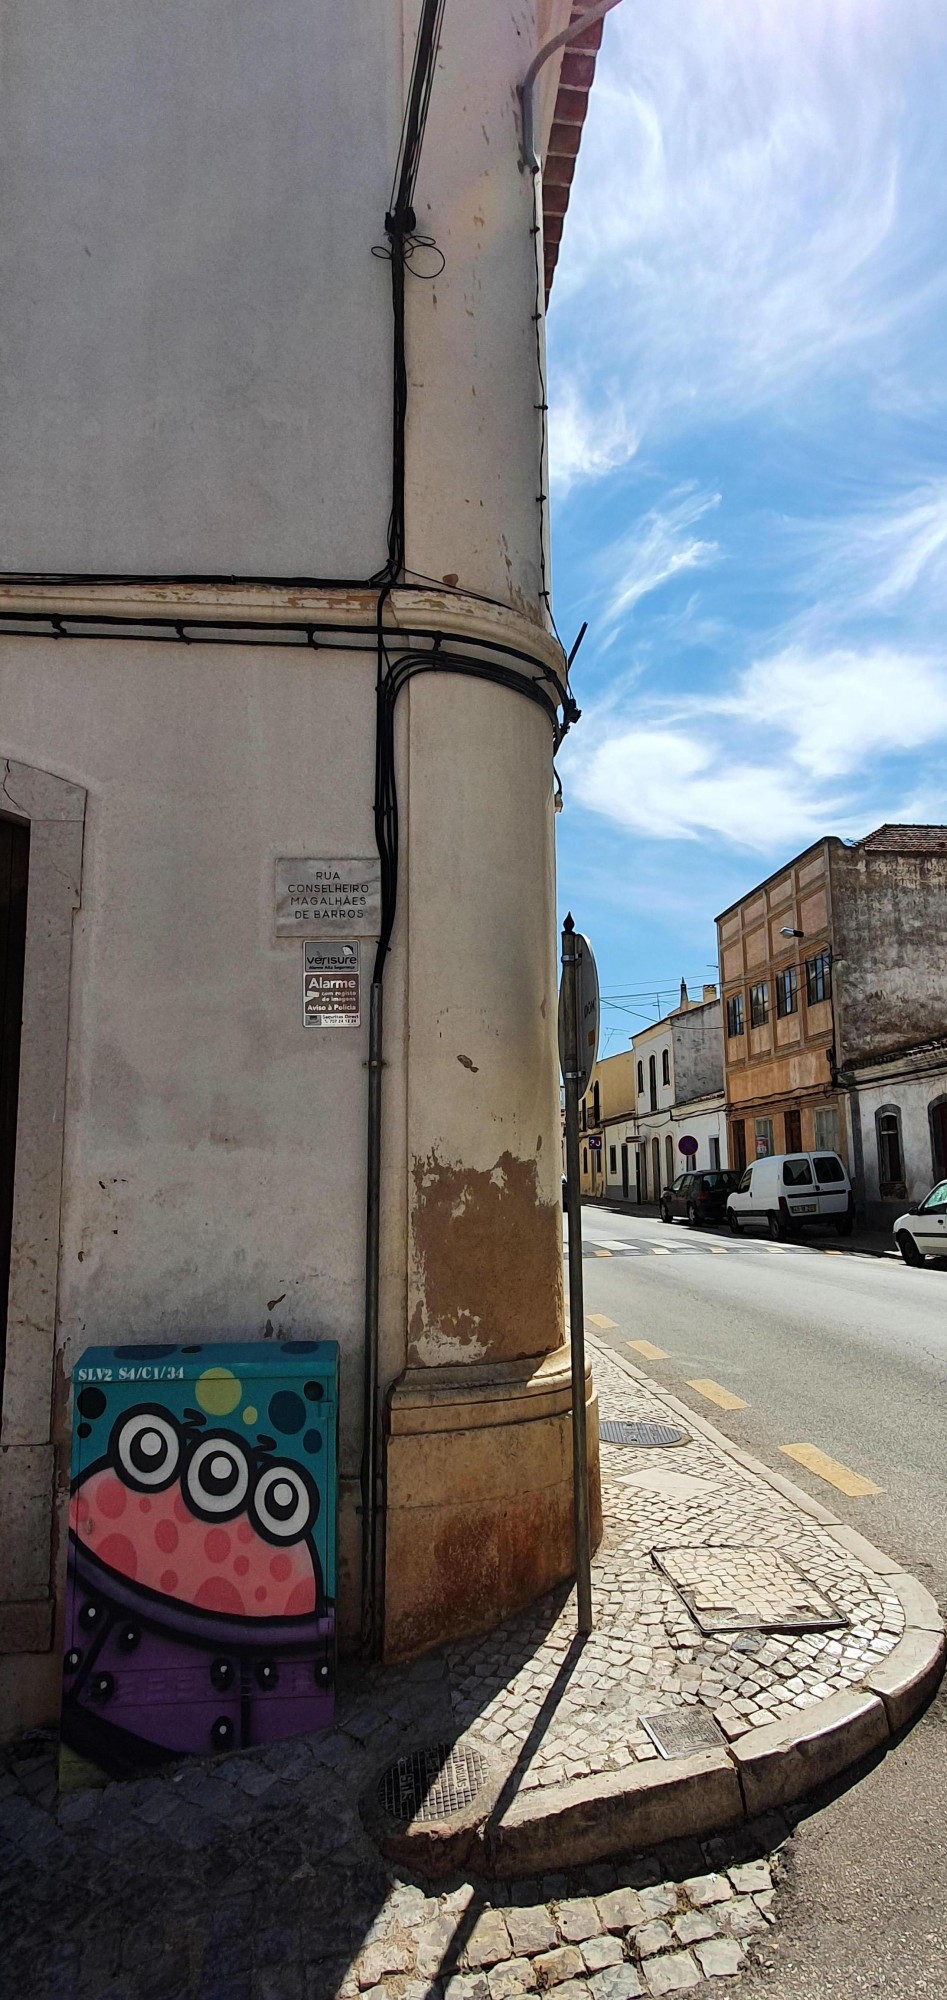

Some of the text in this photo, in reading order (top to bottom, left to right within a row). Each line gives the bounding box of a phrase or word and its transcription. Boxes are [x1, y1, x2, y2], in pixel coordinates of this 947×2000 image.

[316, 871, 341, 880] RUA
[287, 884, 369, 893] CONSELHEIRO
[294, 909, 364, 919] DE BARROS
[306, 956, 357, 965] verisure
[308, 977, 356, 989] Alarme
[78, 1369, 112, 1381] SLV2
